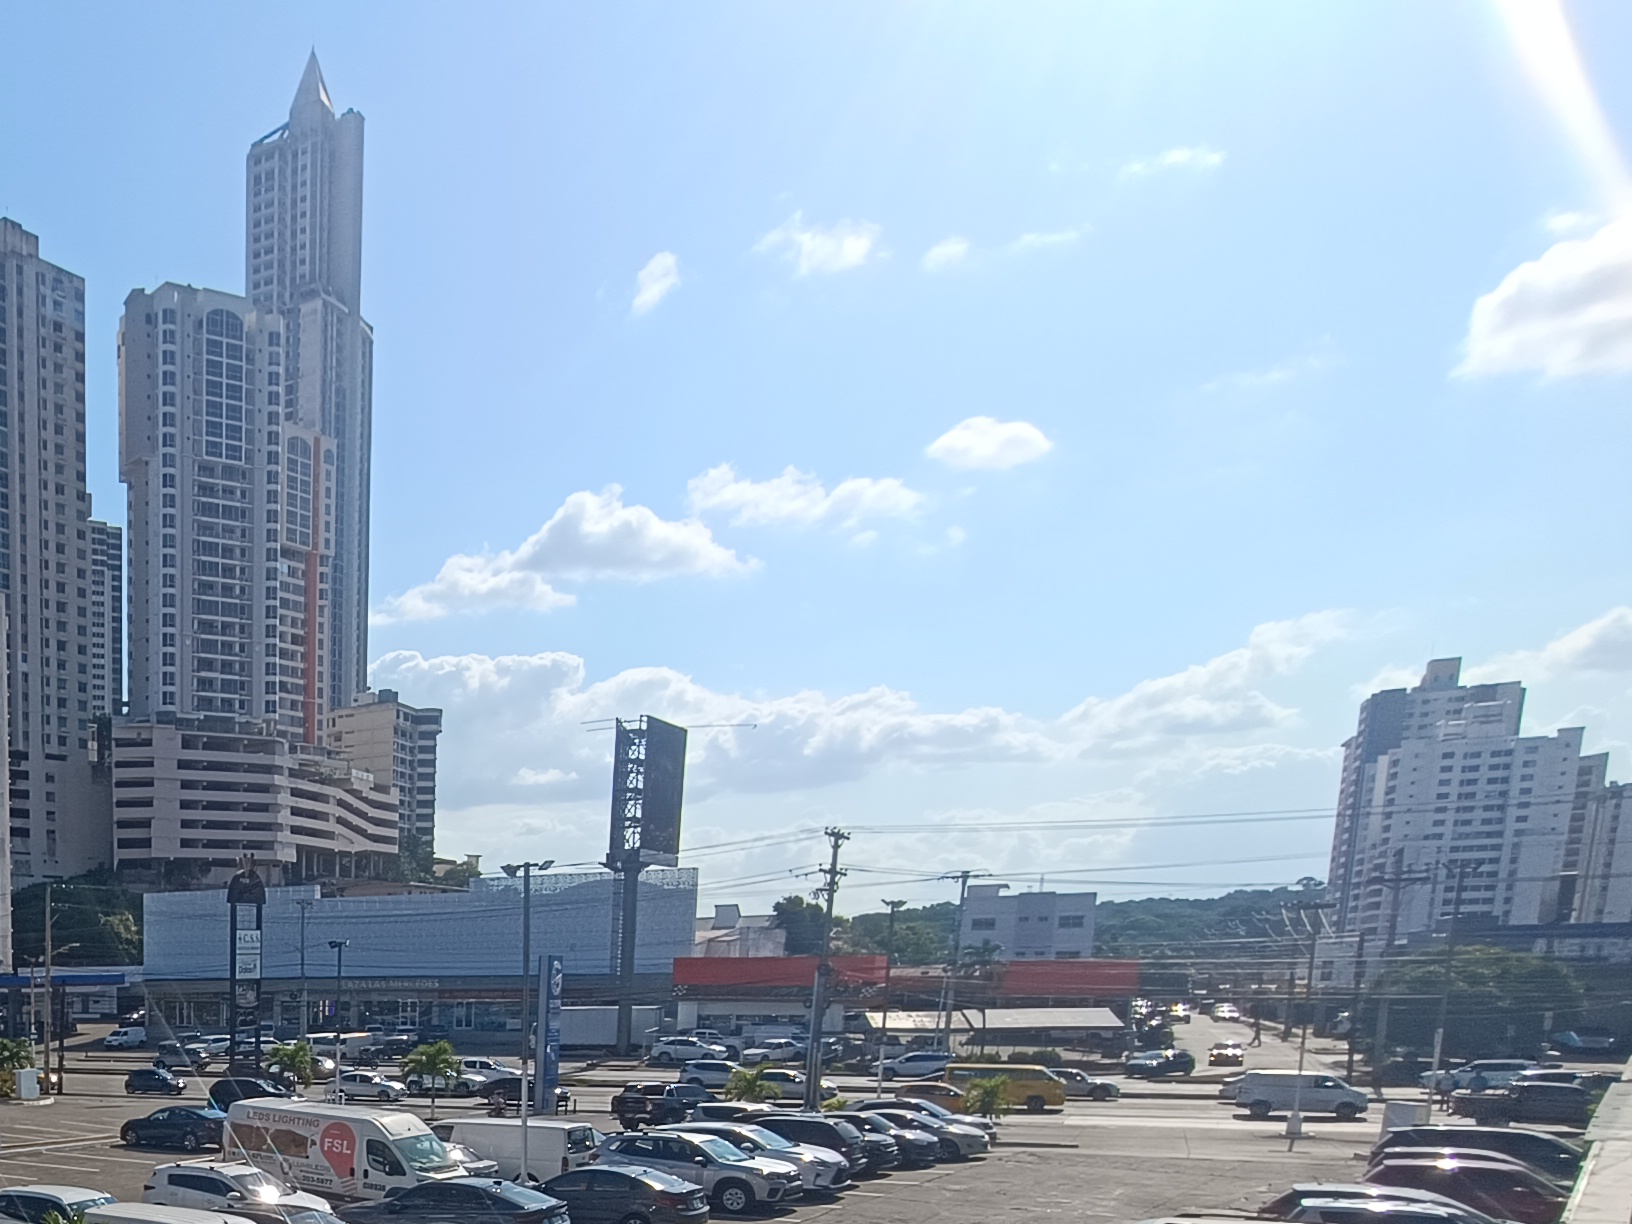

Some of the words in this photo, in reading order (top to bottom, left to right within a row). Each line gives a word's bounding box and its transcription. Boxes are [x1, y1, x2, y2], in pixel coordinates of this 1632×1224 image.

[246, 1110, 271, 1122] LEDS
[272, 1114, 320, 1128] LIGHTING
[324, 1138, 351, 1154] FSL
